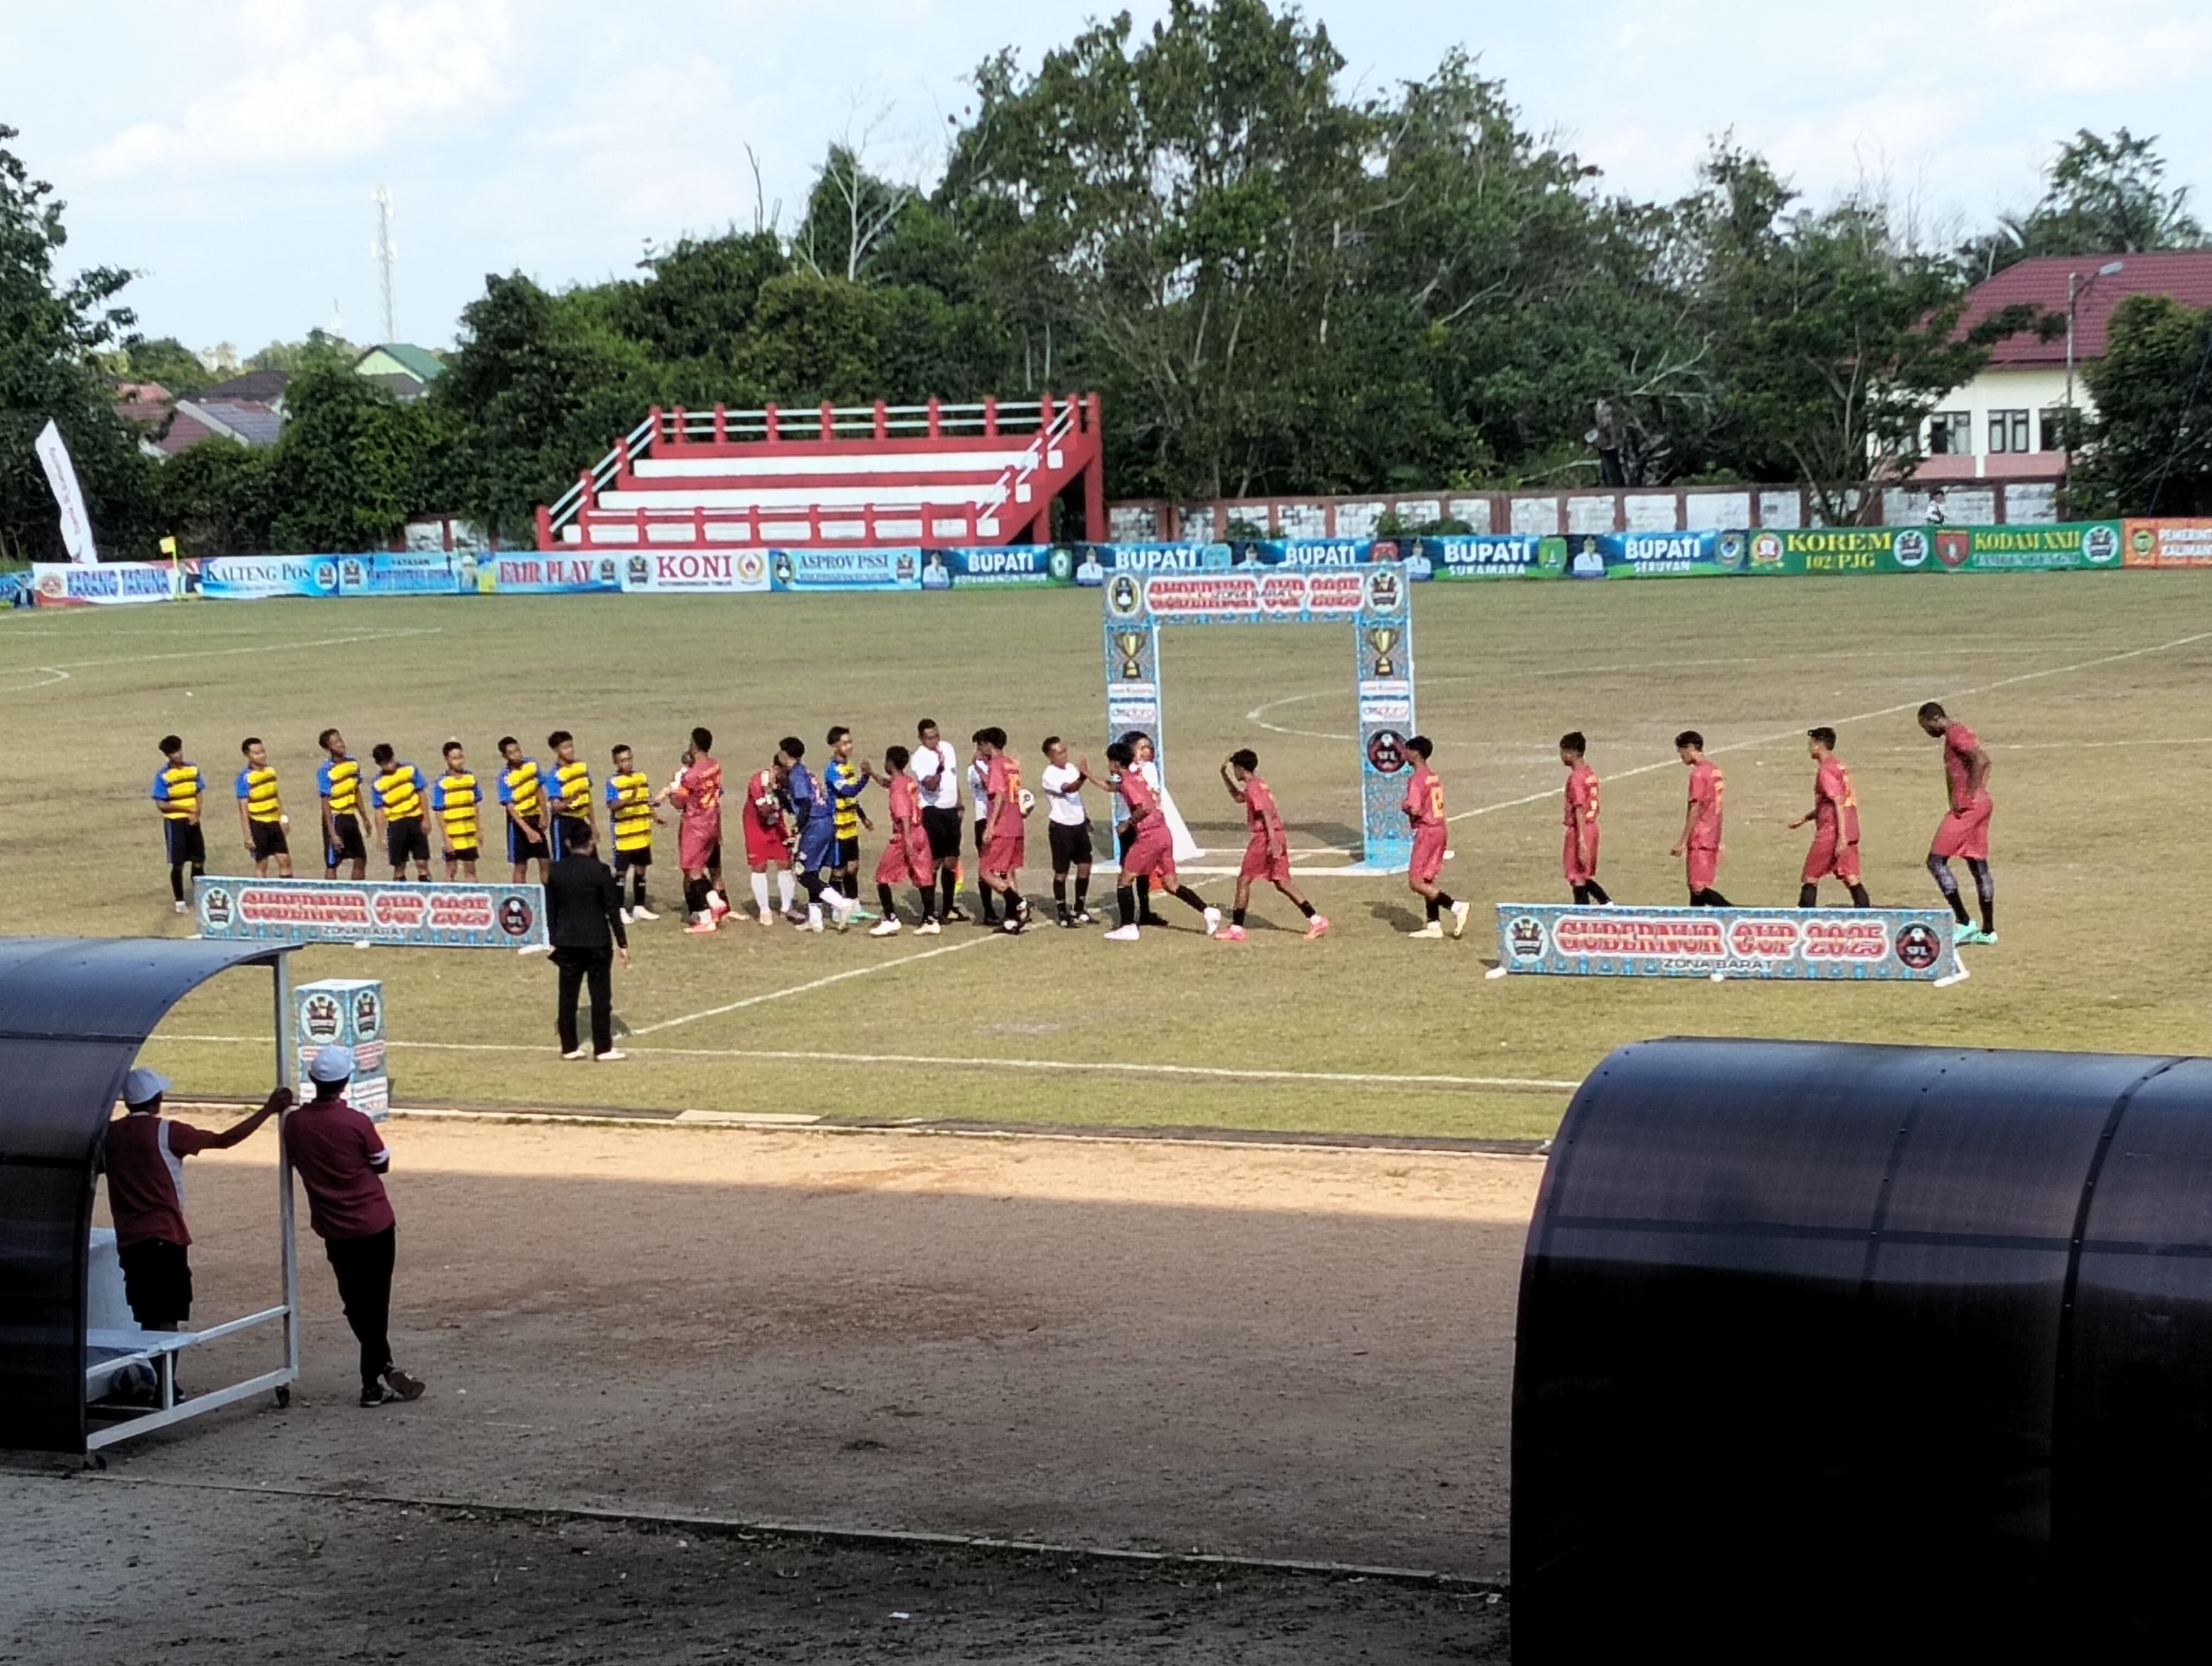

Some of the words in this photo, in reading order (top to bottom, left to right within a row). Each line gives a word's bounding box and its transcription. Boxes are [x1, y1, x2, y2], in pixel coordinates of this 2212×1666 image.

[1624, 538, 1701, 560] BUPATI
[1787, 532, 1892, 552] KOREM
[1975, 533, 2040, 550] KODAM
[799, 555, 855, 569] ASPROV
[857, 554, 889, 568] PSSI
[1115, 549, 1197, 570] BUPATI
[1285, 546, 1355, 565] BUPATI
[1444, 541, 1531, 563] BUPATI
[499, 561, 541, 583] FAIR
[545, 560, 594, 583] PLAY
[656, 555, 732, 578] KONI
[968, 553, 1034, 573] BUPATI
[1448, 564, 1527, 576] SUKAMARA
[1557, 919, 1726, 954] GUBERNUR
[1732, 922, 1798, 956] CUP
[1806, 923, 1887, 958] 2025
[1664, 958, 1709, 969] ZONA
[1716, 959, 1773, 970] BARAT
